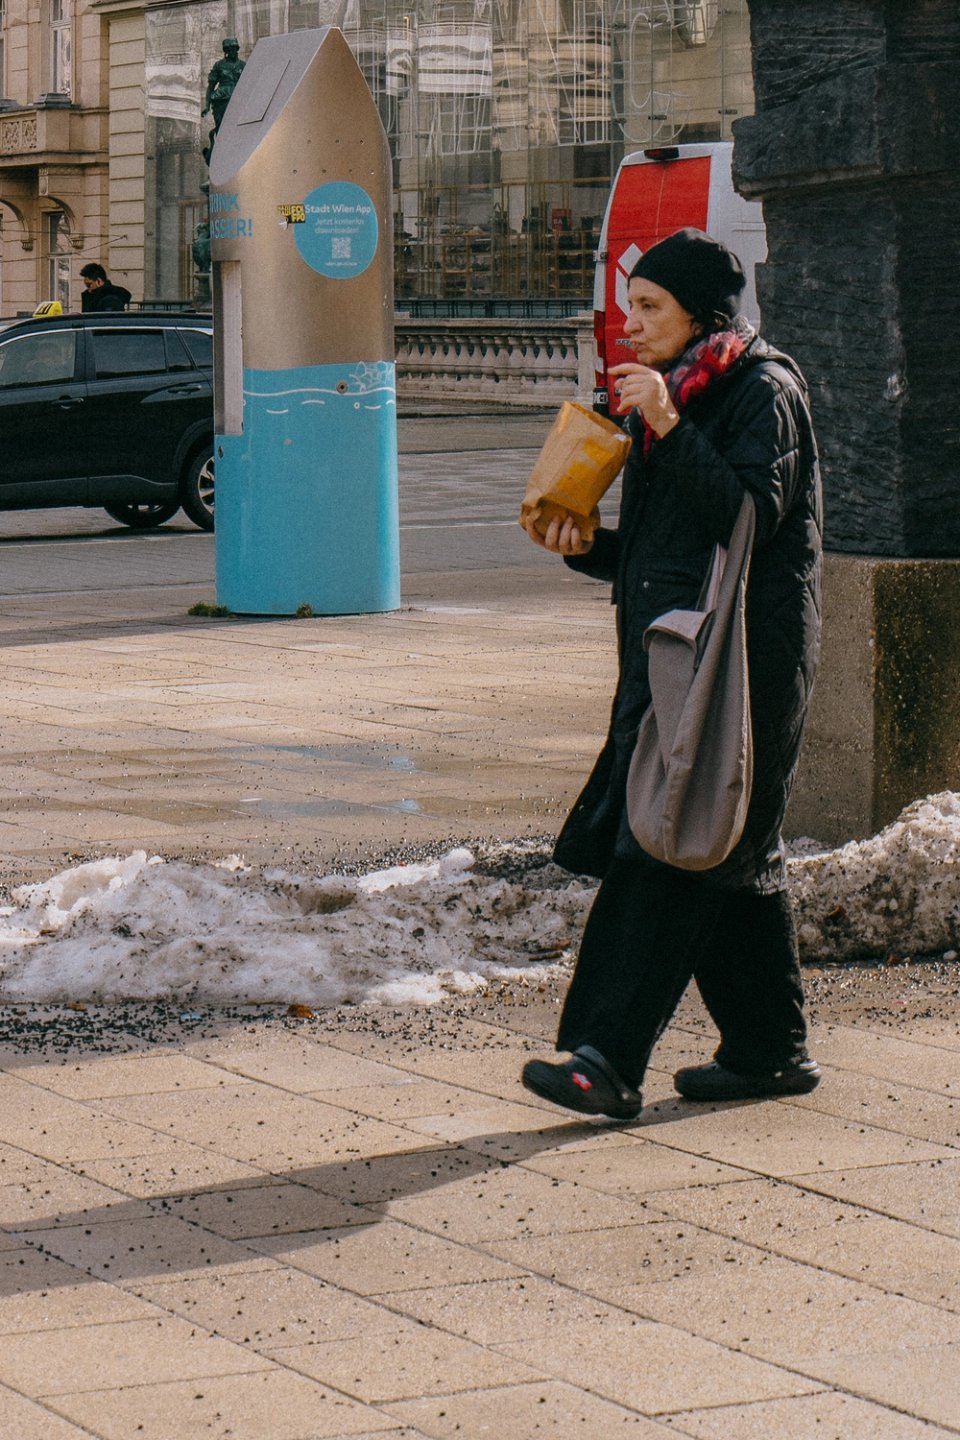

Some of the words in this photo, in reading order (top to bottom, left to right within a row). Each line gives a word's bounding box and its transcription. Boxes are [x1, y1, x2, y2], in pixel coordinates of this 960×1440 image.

[304, 204, 330, 213] Stadt
[332, 204, 355, 213] Wien
[356, 204, 371, 216] App
